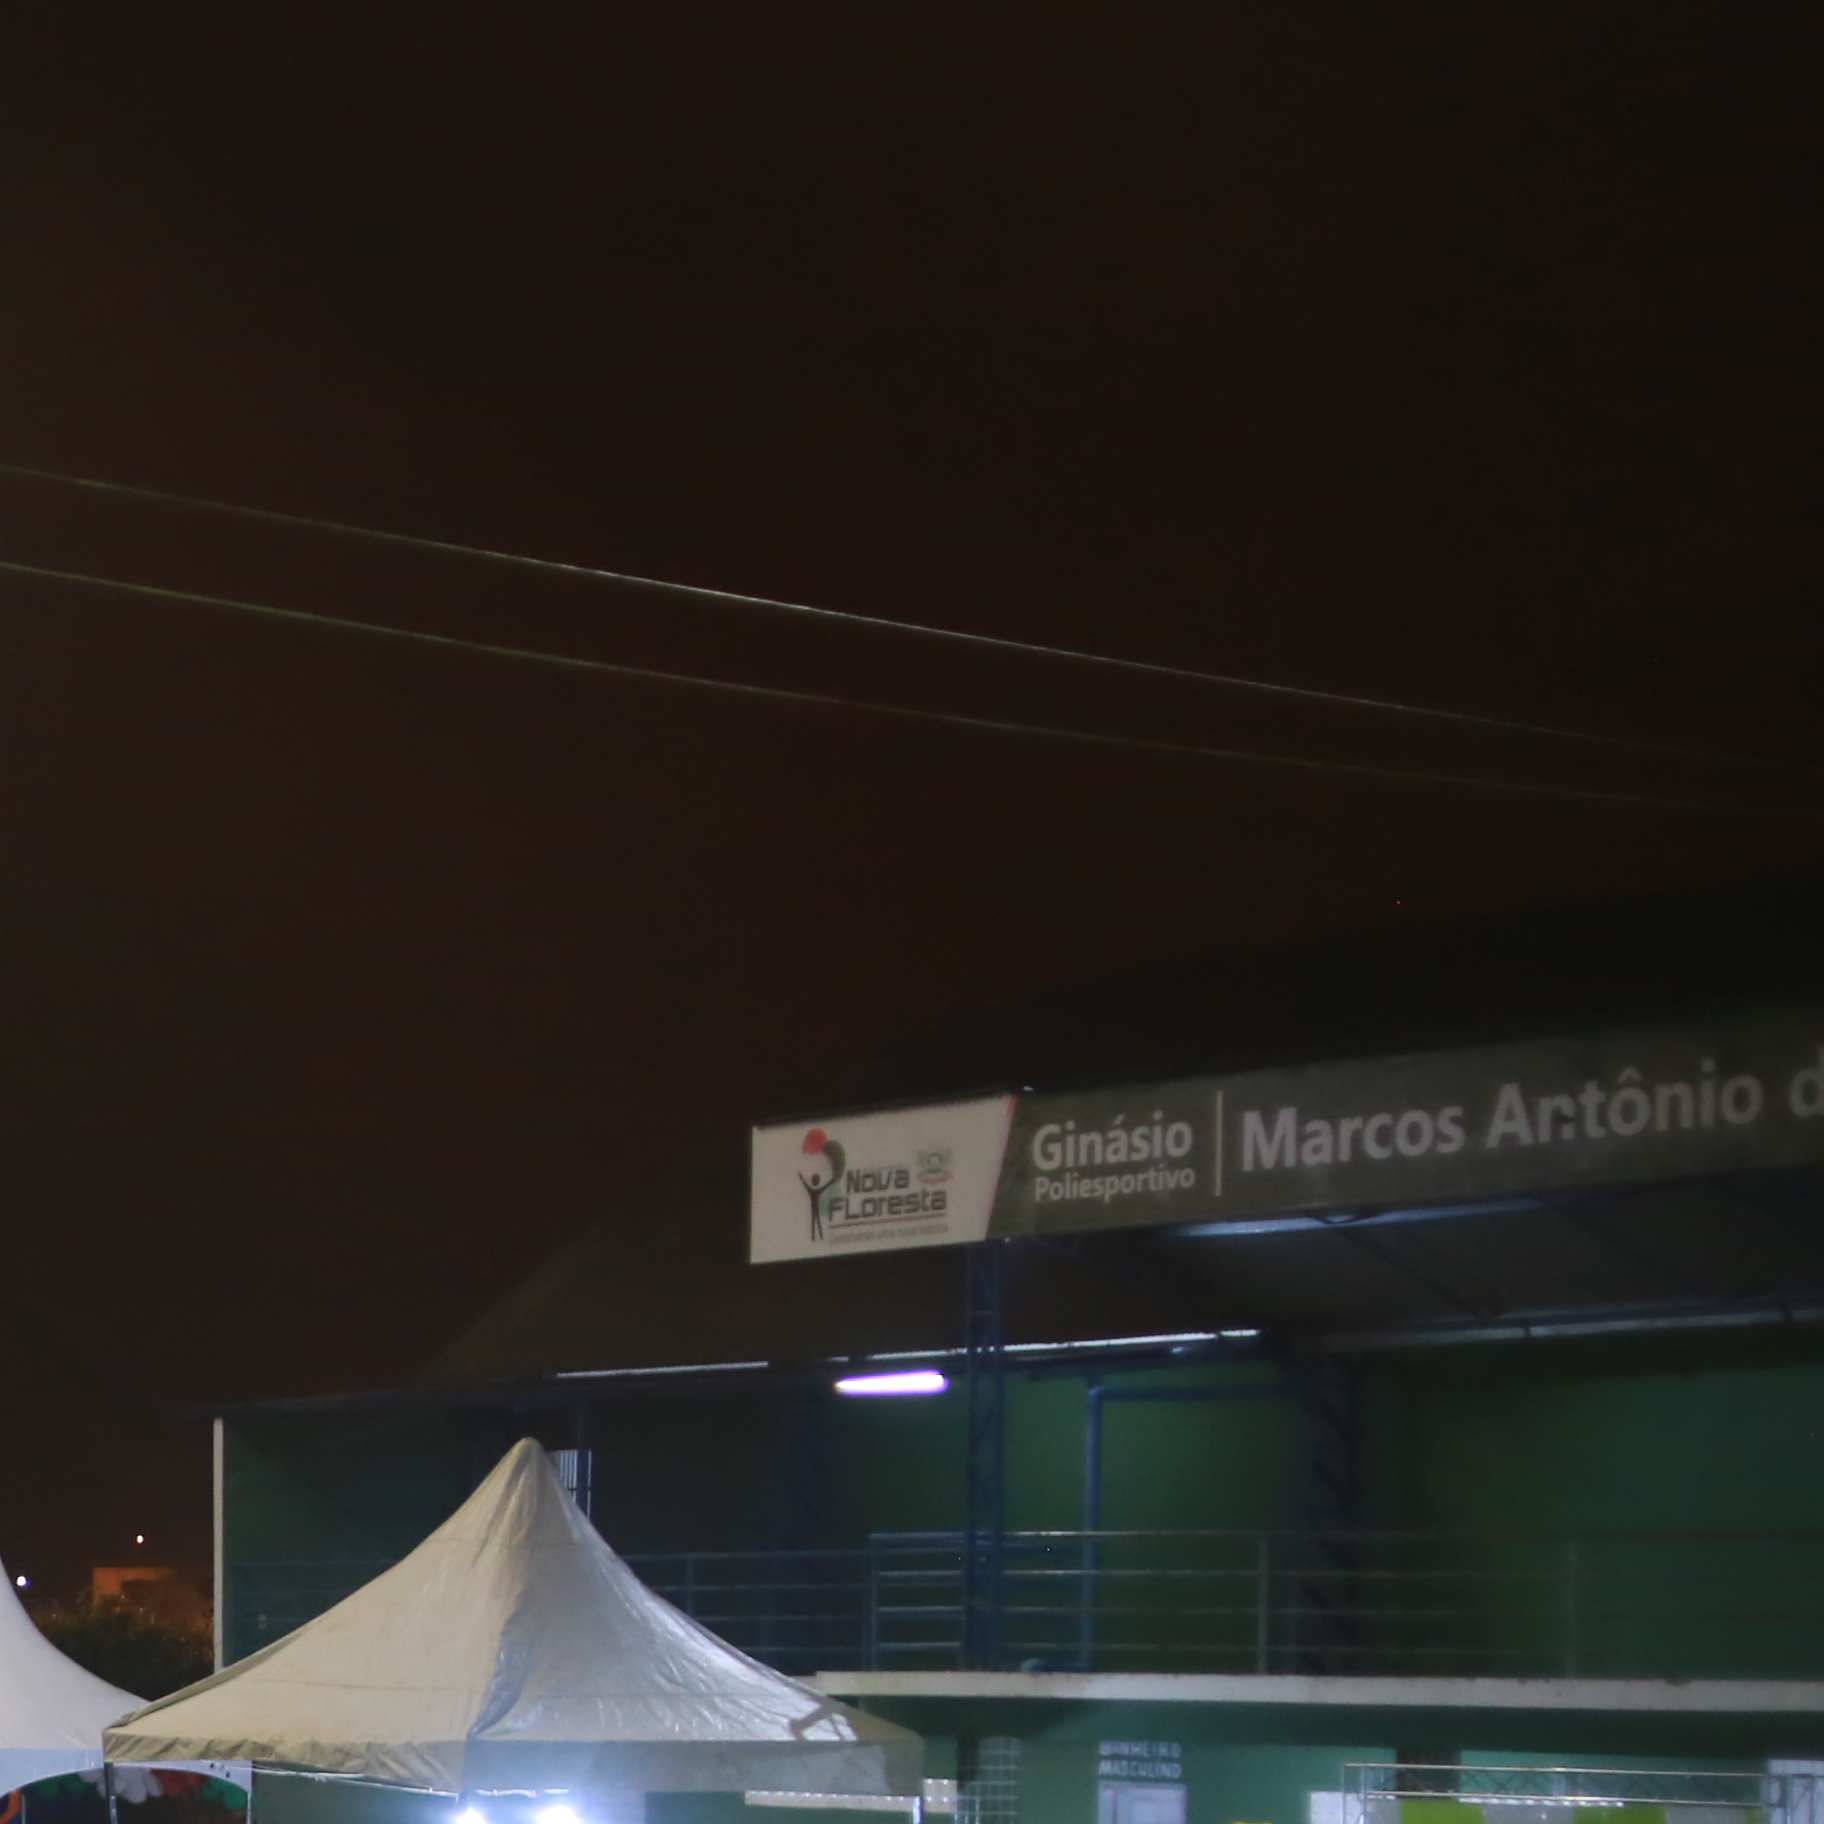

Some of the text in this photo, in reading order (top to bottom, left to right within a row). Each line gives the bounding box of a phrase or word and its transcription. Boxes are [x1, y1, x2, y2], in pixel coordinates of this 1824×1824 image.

[1033, 1110, 1193, 1170] Ginásio
[1243, 1105, 1466, 1171] Marcos
[1486, 1058, 1764, 1150] Antônio
[1035, 1162, 1196, 1204] Poliesportivo
